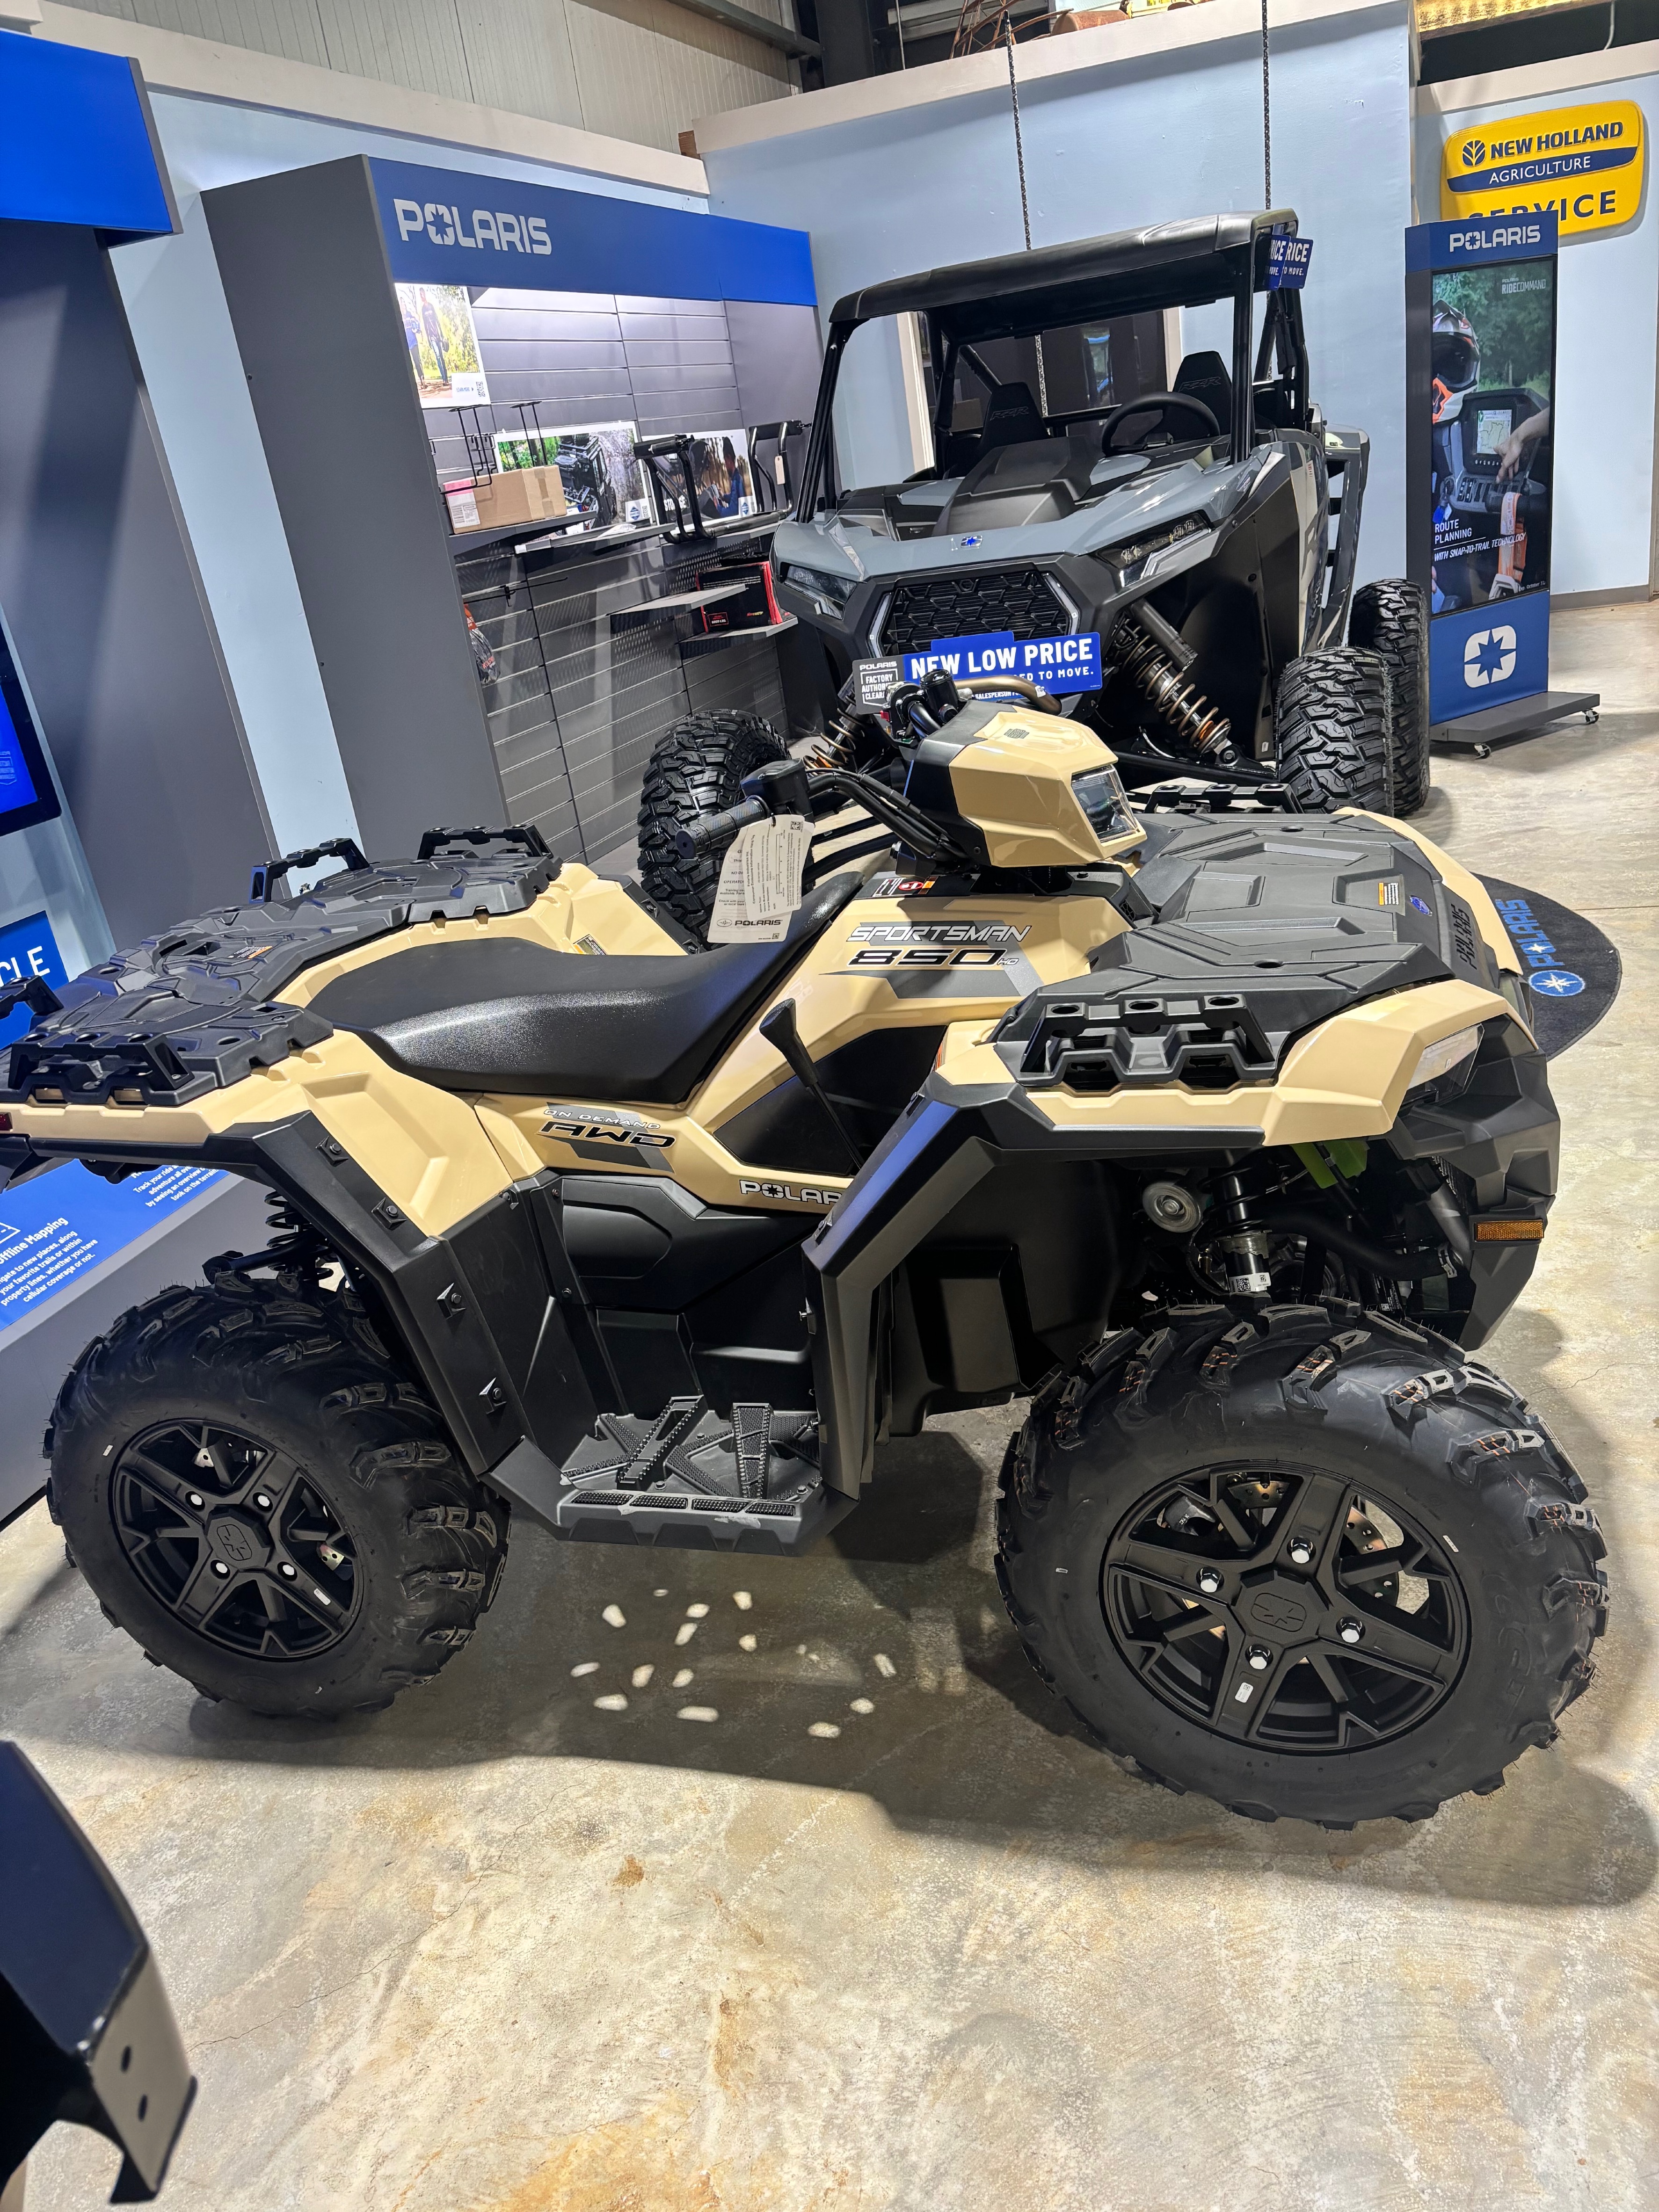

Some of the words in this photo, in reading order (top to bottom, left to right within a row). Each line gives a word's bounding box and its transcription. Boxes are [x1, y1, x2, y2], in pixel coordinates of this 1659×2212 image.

[1491, 138, 1532, 160] NEW
[1537, 122, 1623, 152] HOLLAND
[1489, 156, 1591, 184] AGRICULTURE
[1468, 190, 1616, 221] VICE
[393, 198, 552, 255] POLARIS
[1449, 225, 1541, 252] POLARIS
[1288, 267, 1303, 276] MOVE.
[1502, 279, 1546, 294] RIDECOMMAND
[663, 495, 686, 511] STOGE
[1435, 519, 1459, 533] ROUTE
[1435, 528, 1472, 544] PLANNING
[1434, 550, 1448, 561] WITH
[1449, 541, 1490, 558] SNAP-TO-TRAIL
[1492, 532, 1526, 547] TECHNOLOGY
[859, 661, 897, 670] POLARIS
[911, 653, 960, 679] NEW
[968, 647, 1017, 674] LOW
[1024, 638, 1093, 667] PRICE
[866, 674, 893, 683] FACTORY
[1039, 671, 1053, 680] TO
[1058, 667, 1093, 678] MOVE.
[846, 926, 1032, 942] SPORTSMAN
[1495, 899, 1565, 967] POLARIS
[847, 948, 1007, 967] 850
[544, 1109, 575, 1118] ON
[579, 1112, 661, 1130] DEMAND
[537, 1120, 676, 1149] AWD
[133, 1181, 152, 1193] Track
[150, 1173, 163, 1184] your
[162, 1167, 174, 1176] ride
[148, 1175, 176, 1195] adventure
[153, 1189, 174, 1203] seeing
[179, 1170, 202, 1186] overview
[171, 1190, 186, 1201] took
[24, 1217, 69, 1245] Mapping
[22, 1256, 37, 1269] new
[38, 1242, 60, 1259] places,
[58, 1230, 78, 1246] along
[0, 1284, 15, 1296] your
[13, 1266, 40, 1284] favorite
[39, 1256, 56, 1268] trails
[63, 1238, 82, 1253] within
[0, 1285, 31, 1306] property
[29, 1274, 48, 1287] lines,
[46, 1258, 72, 1275] whether
[71, 1248, 84, 1259] you
[82, 1239, 98, 1251] have
[23, 1284, 48, 1303] cellular
[48, 1266, 76, 1286] coverage
[81, 1254, 96, 1263] not.
